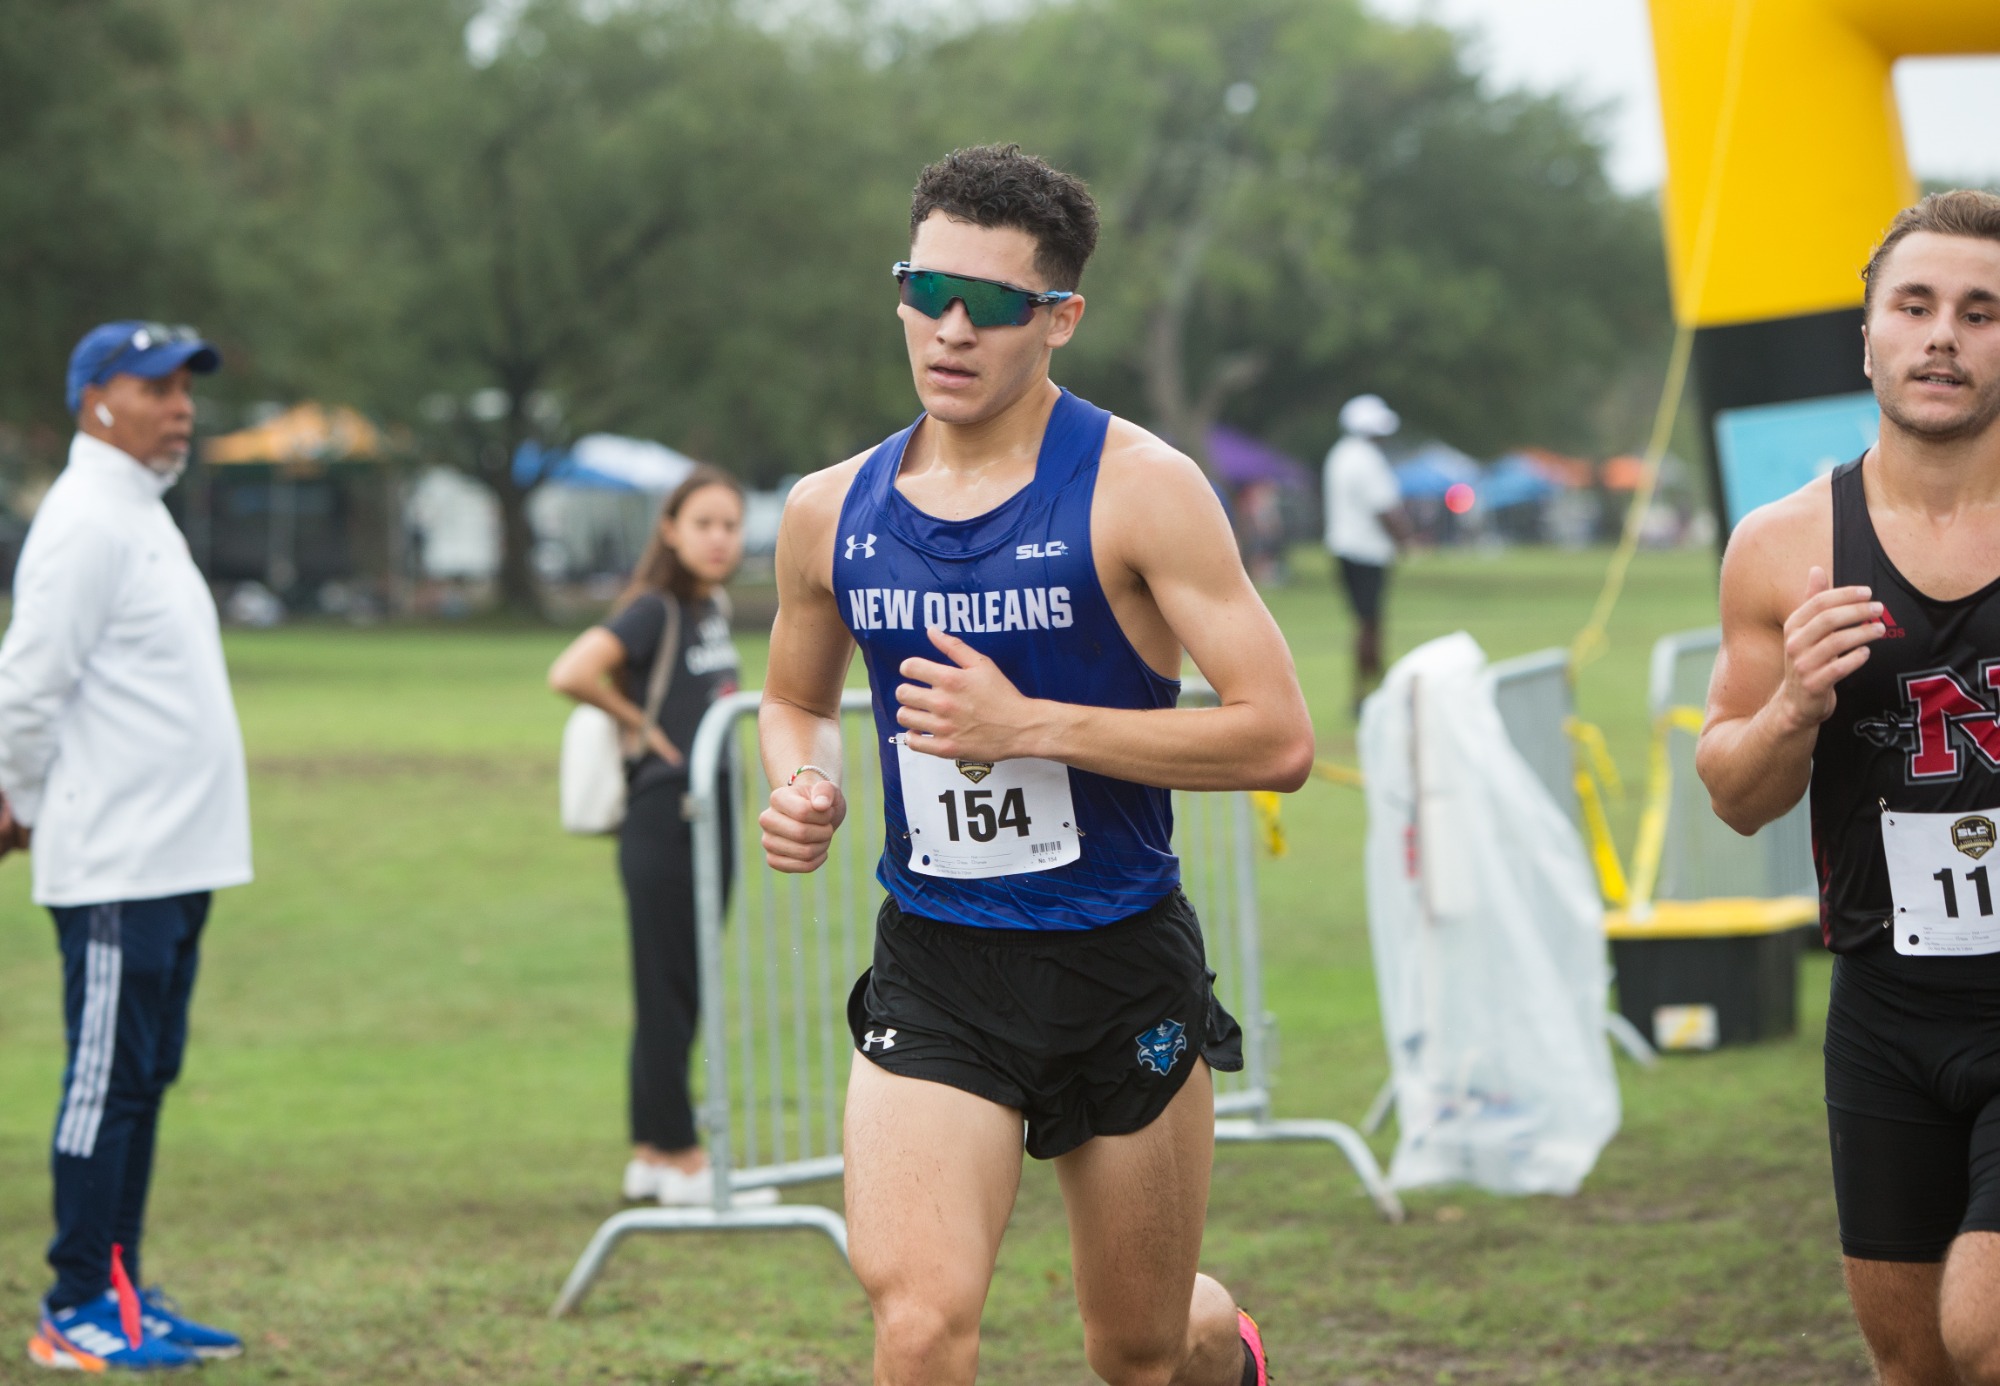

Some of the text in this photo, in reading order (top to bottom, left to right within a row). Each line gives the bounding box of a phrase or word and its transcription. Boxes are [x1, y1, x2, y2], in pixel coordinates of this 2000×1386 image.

[1016, 541, 1063, 560] SLC
[848, 586, 1074, 634] NEW ORLEANS
[938, 787, 1032, 843] 154
